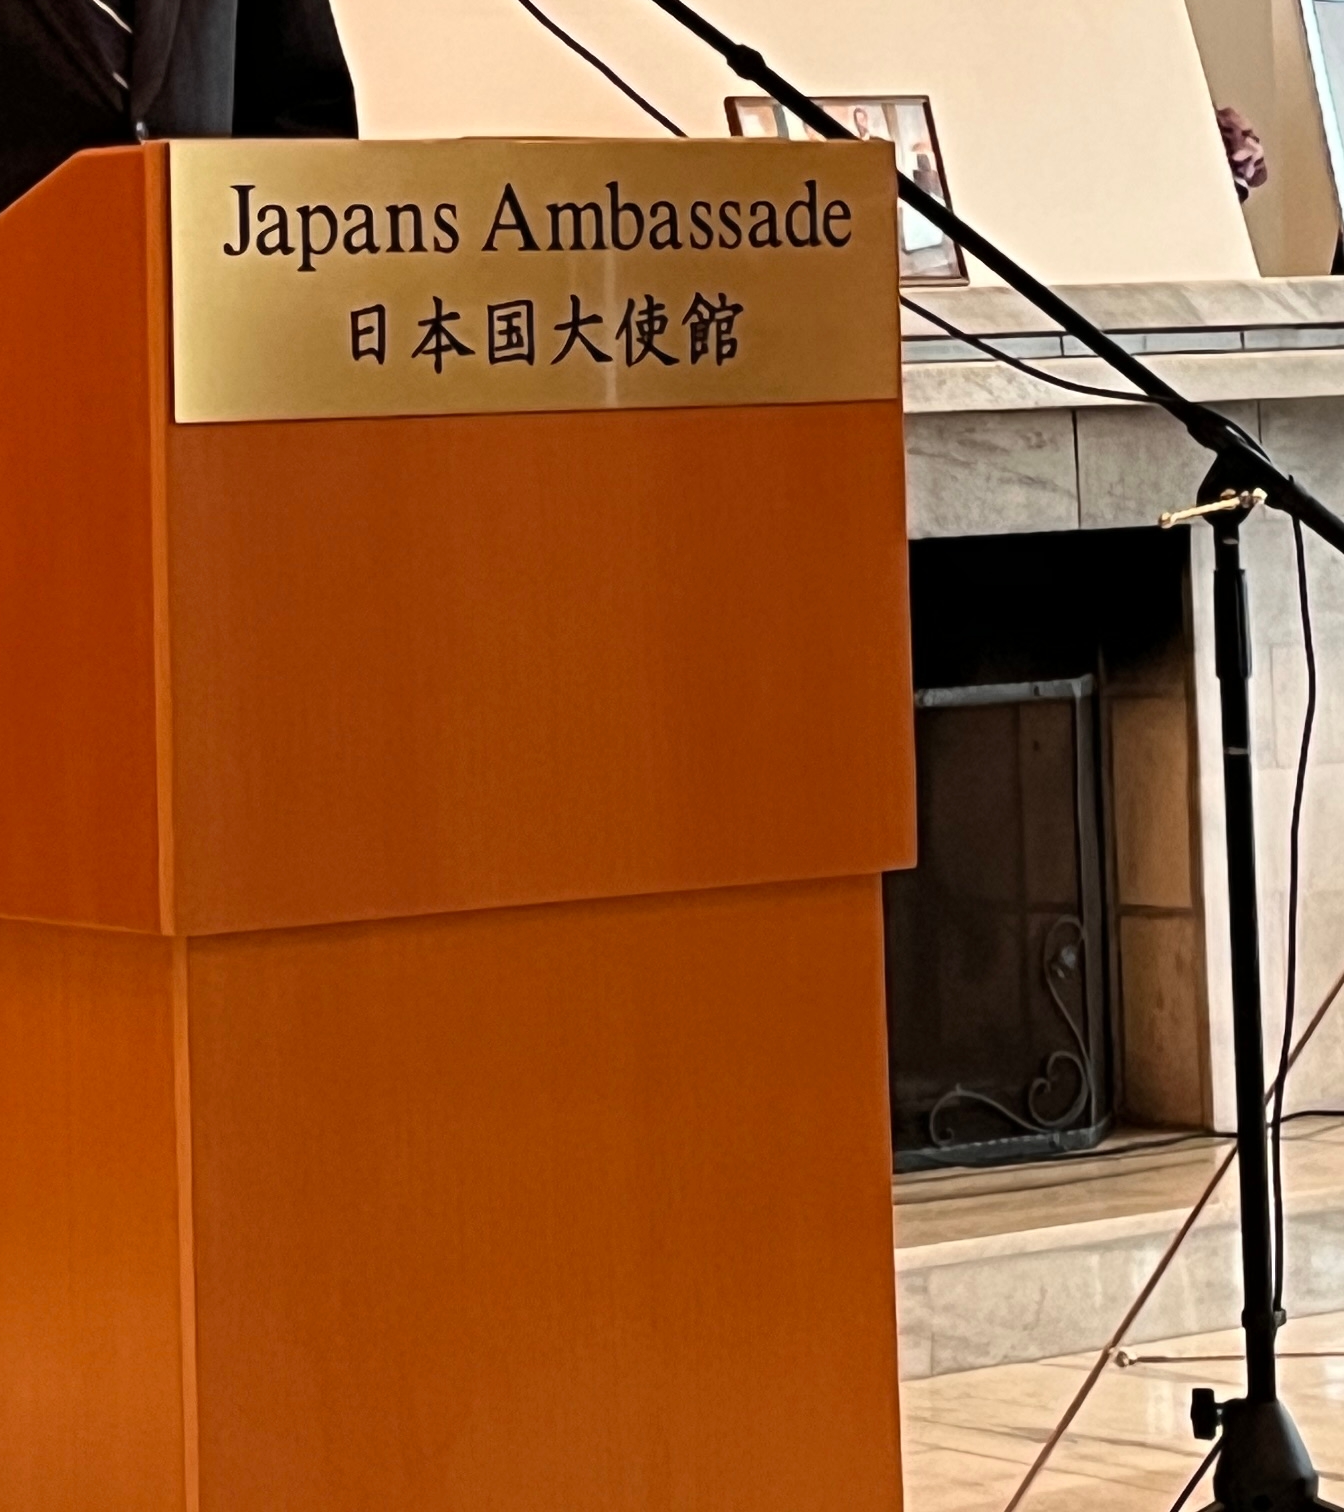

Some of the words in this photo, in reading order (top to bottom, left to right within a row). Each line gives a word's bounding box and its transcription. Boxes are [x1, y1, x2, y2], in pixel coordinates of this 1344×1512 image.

[223, 184, 459, 272] Japans
[481, 179, 853, 252] Ambassade
[349, 292, 744, 374] 日本国大使館
